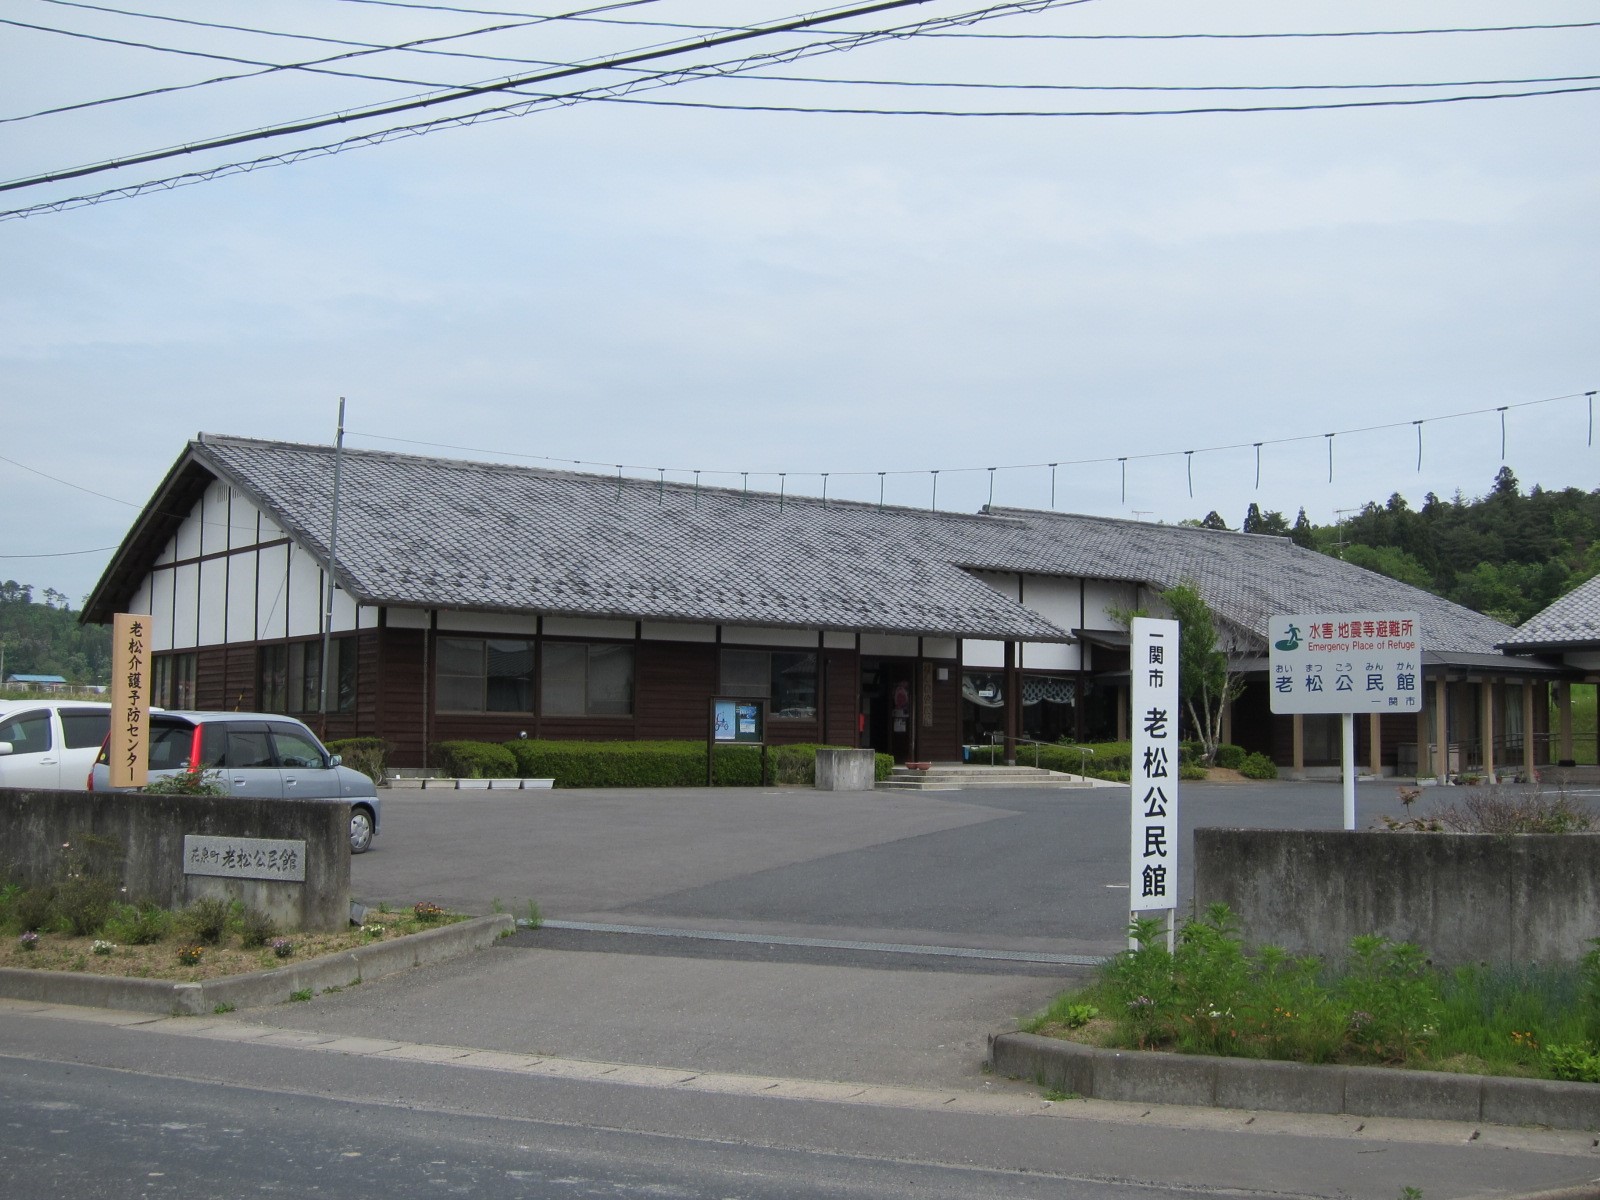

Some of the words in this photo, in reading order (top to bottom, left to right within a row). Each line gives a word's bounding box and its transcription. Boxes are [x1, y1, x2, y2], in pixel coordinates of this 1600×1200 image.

[1308, 642, 1349, 652] Emergency
[1353, 641, 1374, 650] Place
[1377, 641, 1385, 649] of
[1388, 640, 1416, 650] Refuge
[1149, 633, 1164, 688] 一関市
[1275, 664, 1293, 673] おい
[1305, 664, 1323, 672] まつ
[1336, 663, 1353, 672] こう
[1366, 662, 1384, 671] みん
[1396, 662, 1415, 671] かん
[1275, 673, 1416, 693] 老松公民館
[127, 620, 143, 781] 老松介護予防センター
[1372, 697, 1415, 706] 一関市
[1142, 707, 1168, 897] 老松公民館
[222, 845, 298, 872] 老松公民館
